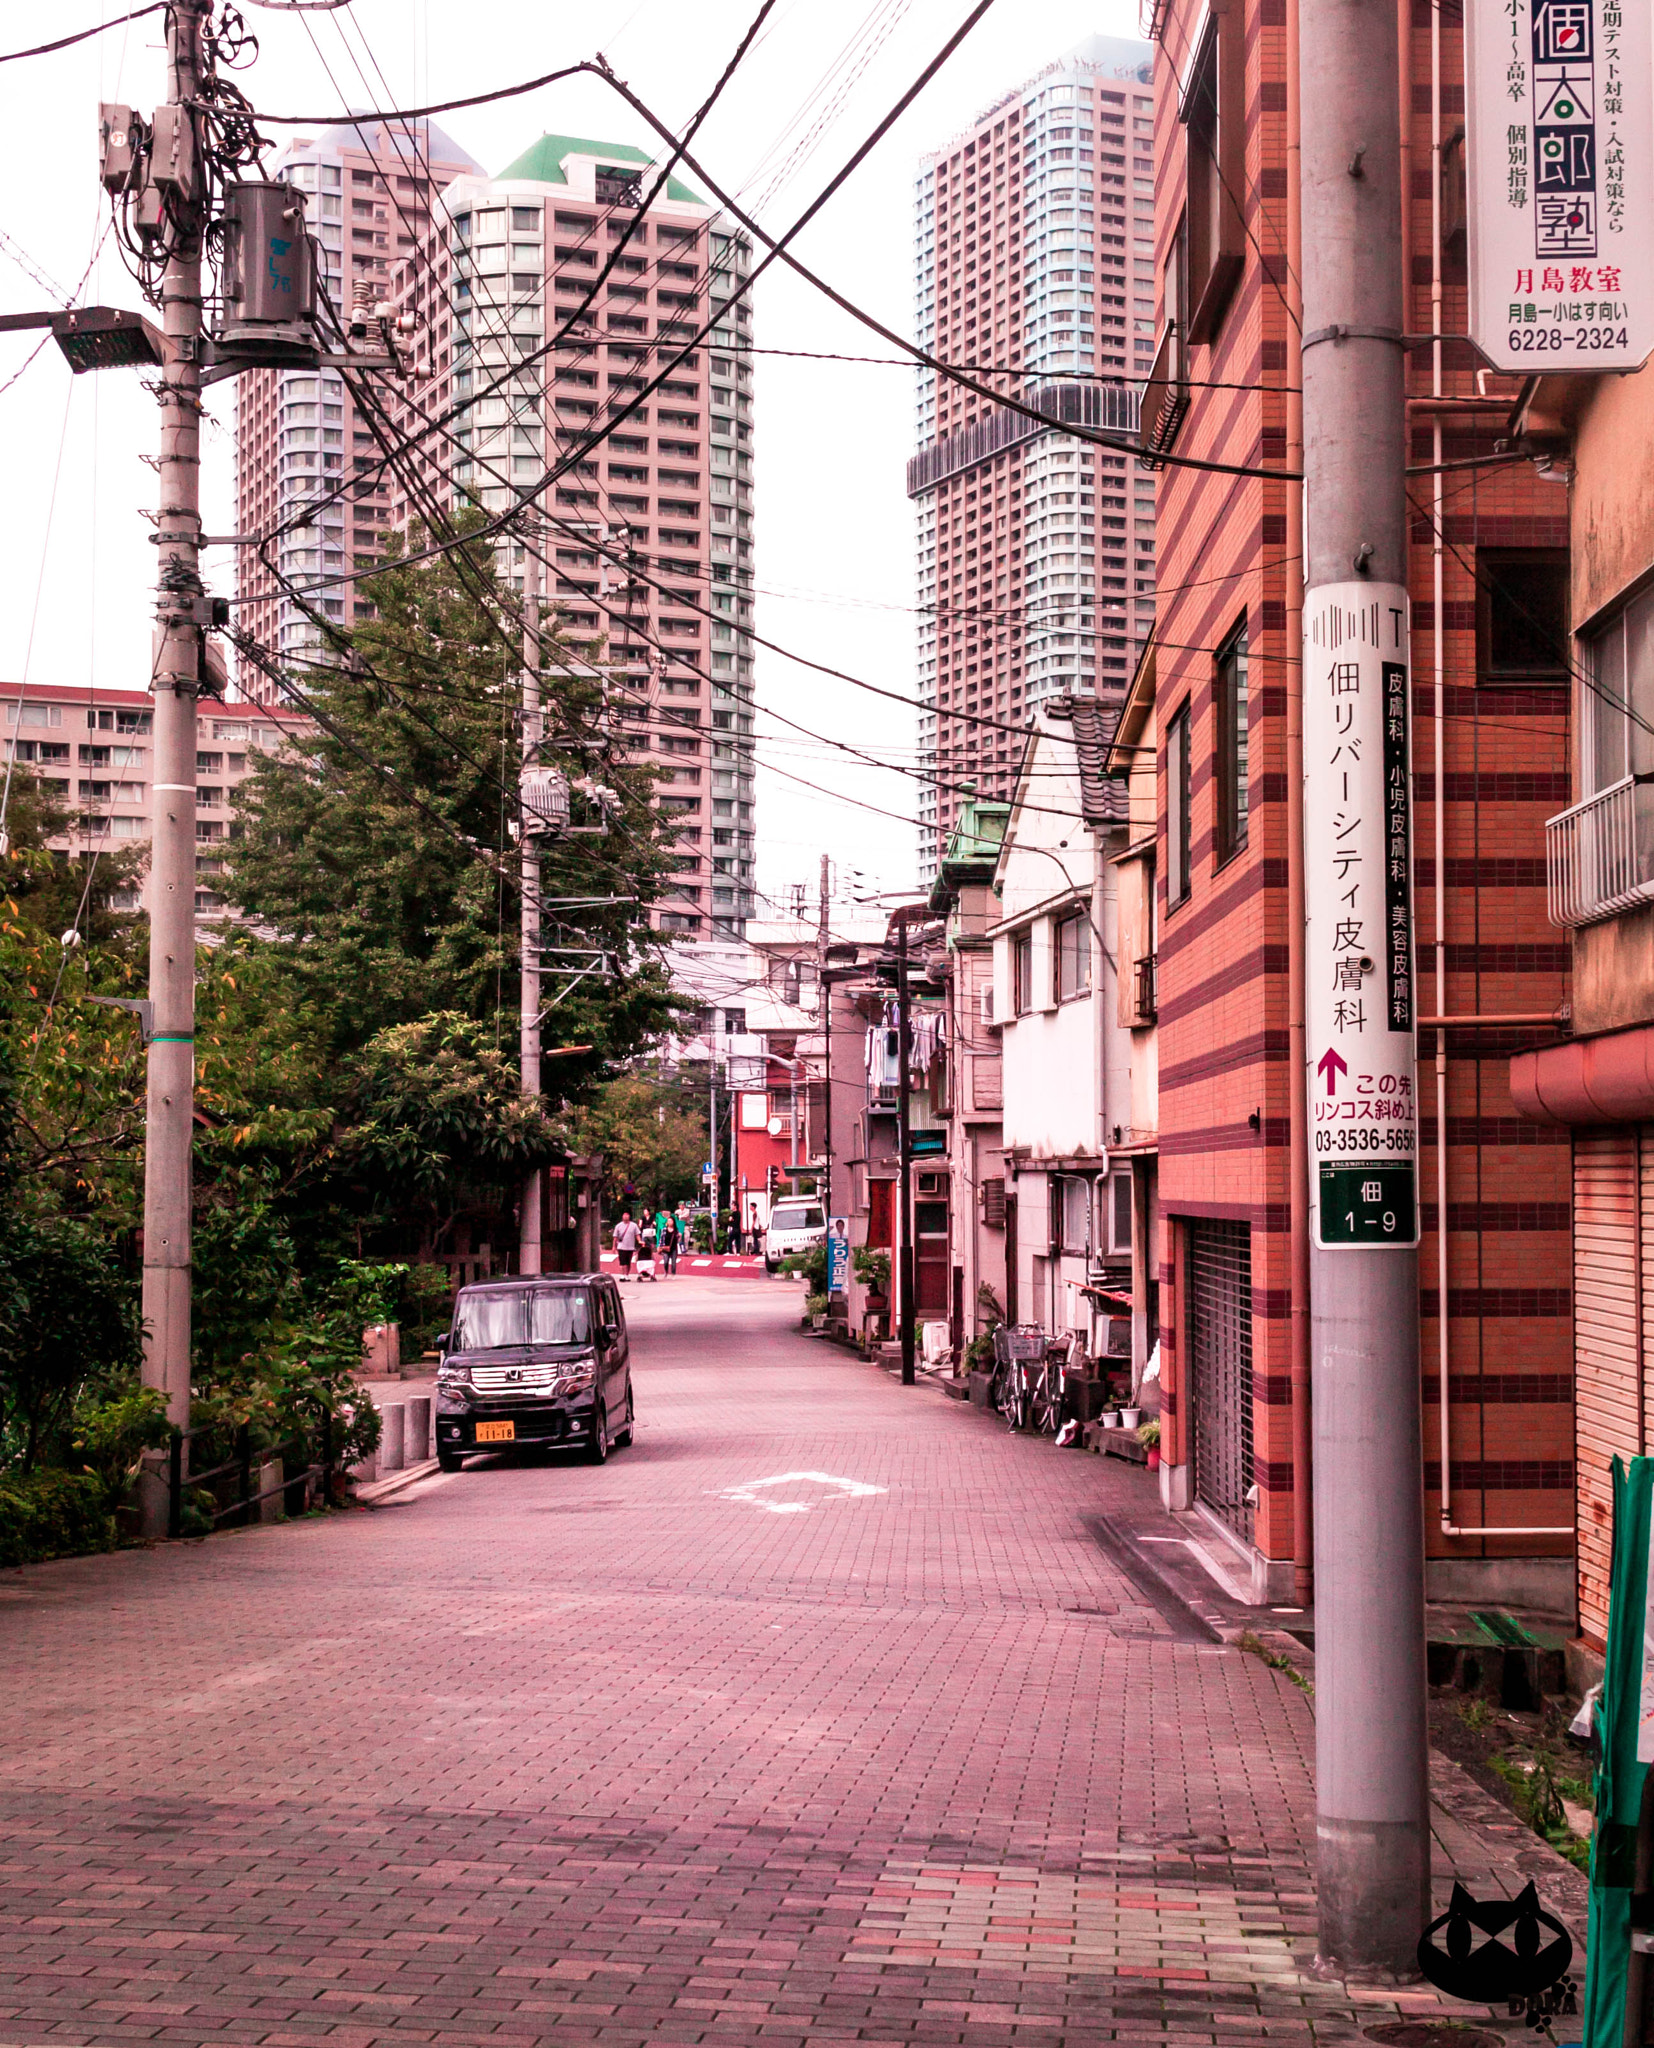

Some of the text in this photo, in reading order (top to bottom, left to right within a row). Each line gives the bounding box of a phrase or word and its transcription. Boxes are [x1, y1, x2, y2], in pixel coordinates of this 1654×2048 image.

[1533, 1, 1594, 251] 個太郎塾
[1506, 124, 1528, 209] 個別指導
[1514, 265, 1622, 294] 月島教室
[1508, 301, 1629, 324] 月島一小はす向い
[1508, 327, 1629, 351] 6228-2324
[1327, 661, 1368, 1034] 佃リバーシティ皮膚科
[1356, 1074, 1411, 1096] この先
[1315, 1098, 1414, 1122] リンコス斜め上
[1315, 1128, 1415, 1152] 03-3536-5656
[1360, 1181, 1382, 1203] 佃
[1345, 1211, 1396, 1232] 1-9
